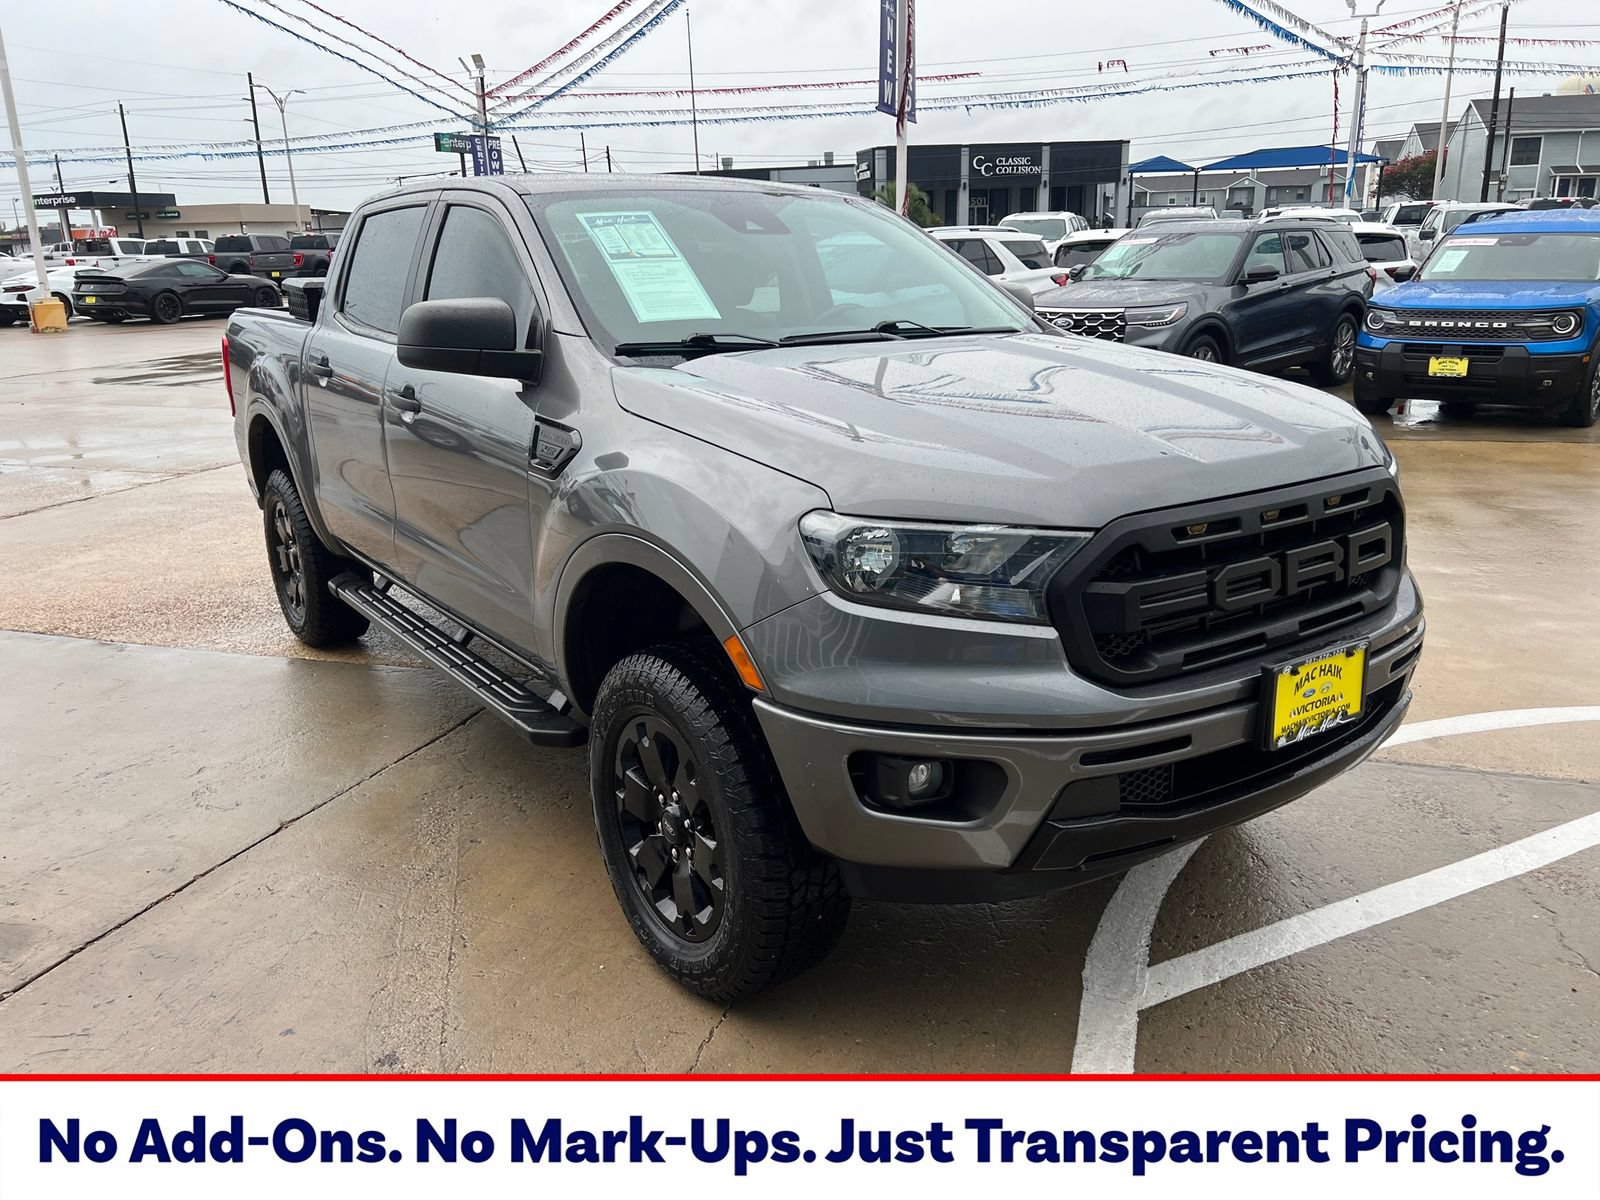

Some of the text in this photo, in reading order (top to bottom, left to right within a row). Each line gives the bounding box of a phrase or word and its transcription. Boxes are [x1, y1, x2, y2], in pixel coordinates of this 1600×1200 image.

[884, 16, 893, 105] NEW
[441, 137, 472, 151] enterp
[488, 140, 501, 149] PRE
[475, 138, 486, 176] CERTI
[996, 157, 1031, 166] CLASSIC
[996, 166, 1042, 175] COLLISION
[34, 195, 77, 207] nterprise
[970, 197, 987, 206] 501
[1409, 320, 1507, 328] BRONCO
[1086, 521, 1392, 634] FORD
[1294, 667, 1318, 695] MAC
[1319, 663, 1343, 680] HAIK
[1296, 694, 1336, 716] VICTORIA
